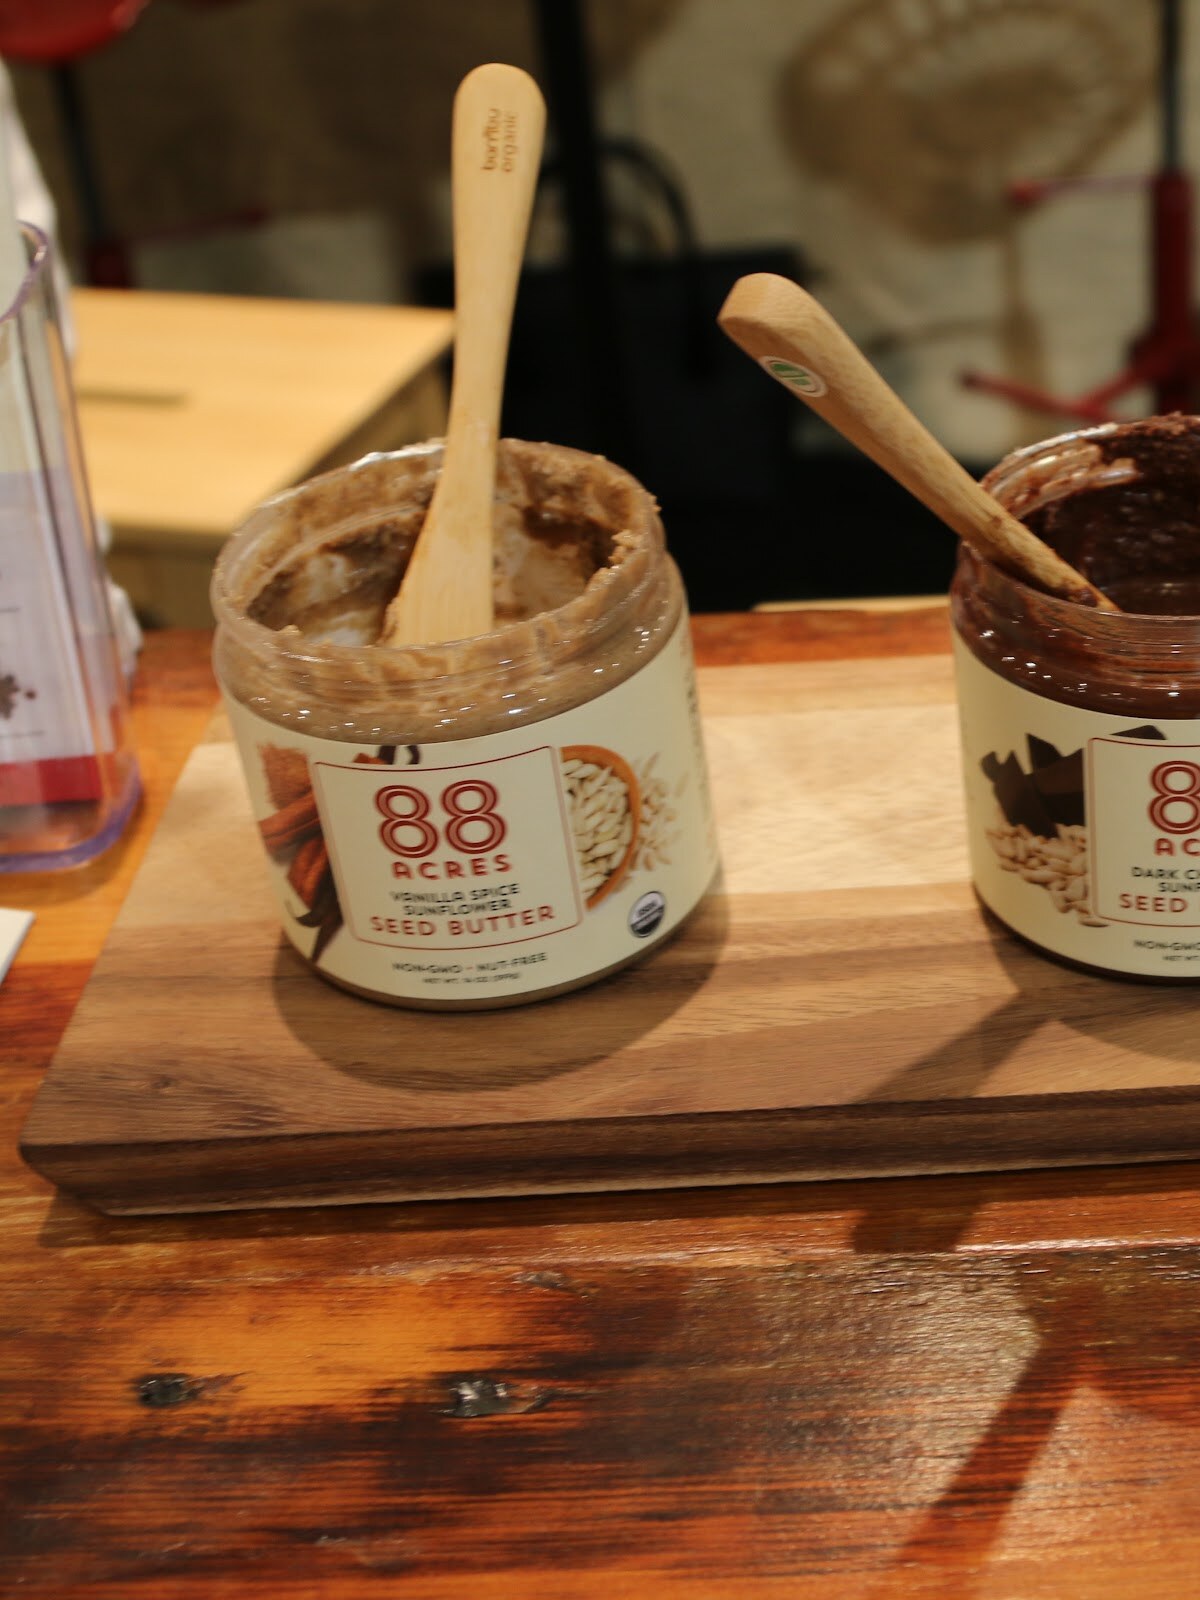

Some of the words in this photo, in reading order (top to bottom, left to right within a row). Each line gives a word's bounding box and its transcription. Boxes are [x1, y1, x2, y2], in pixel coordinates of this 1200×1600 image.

[375, 779, 506, 858] 88
[391, 853, 513, 880] ACRES
[1131, 866, 1179, 880] DARK
[390, 891, 464, 903] VANILLA
[470, 883, 520, 901] SPICE
[1119, 893, 1188, 913] SEED
[403, 899, 512, 916] SUNFLOWER
[370, 916, 437, 936] SEED
[448, 905, 555, 936] BUTTER
[392, 962, 463, 974] NON-GMO
[476, 952, 548, 972] NUT-FREE
